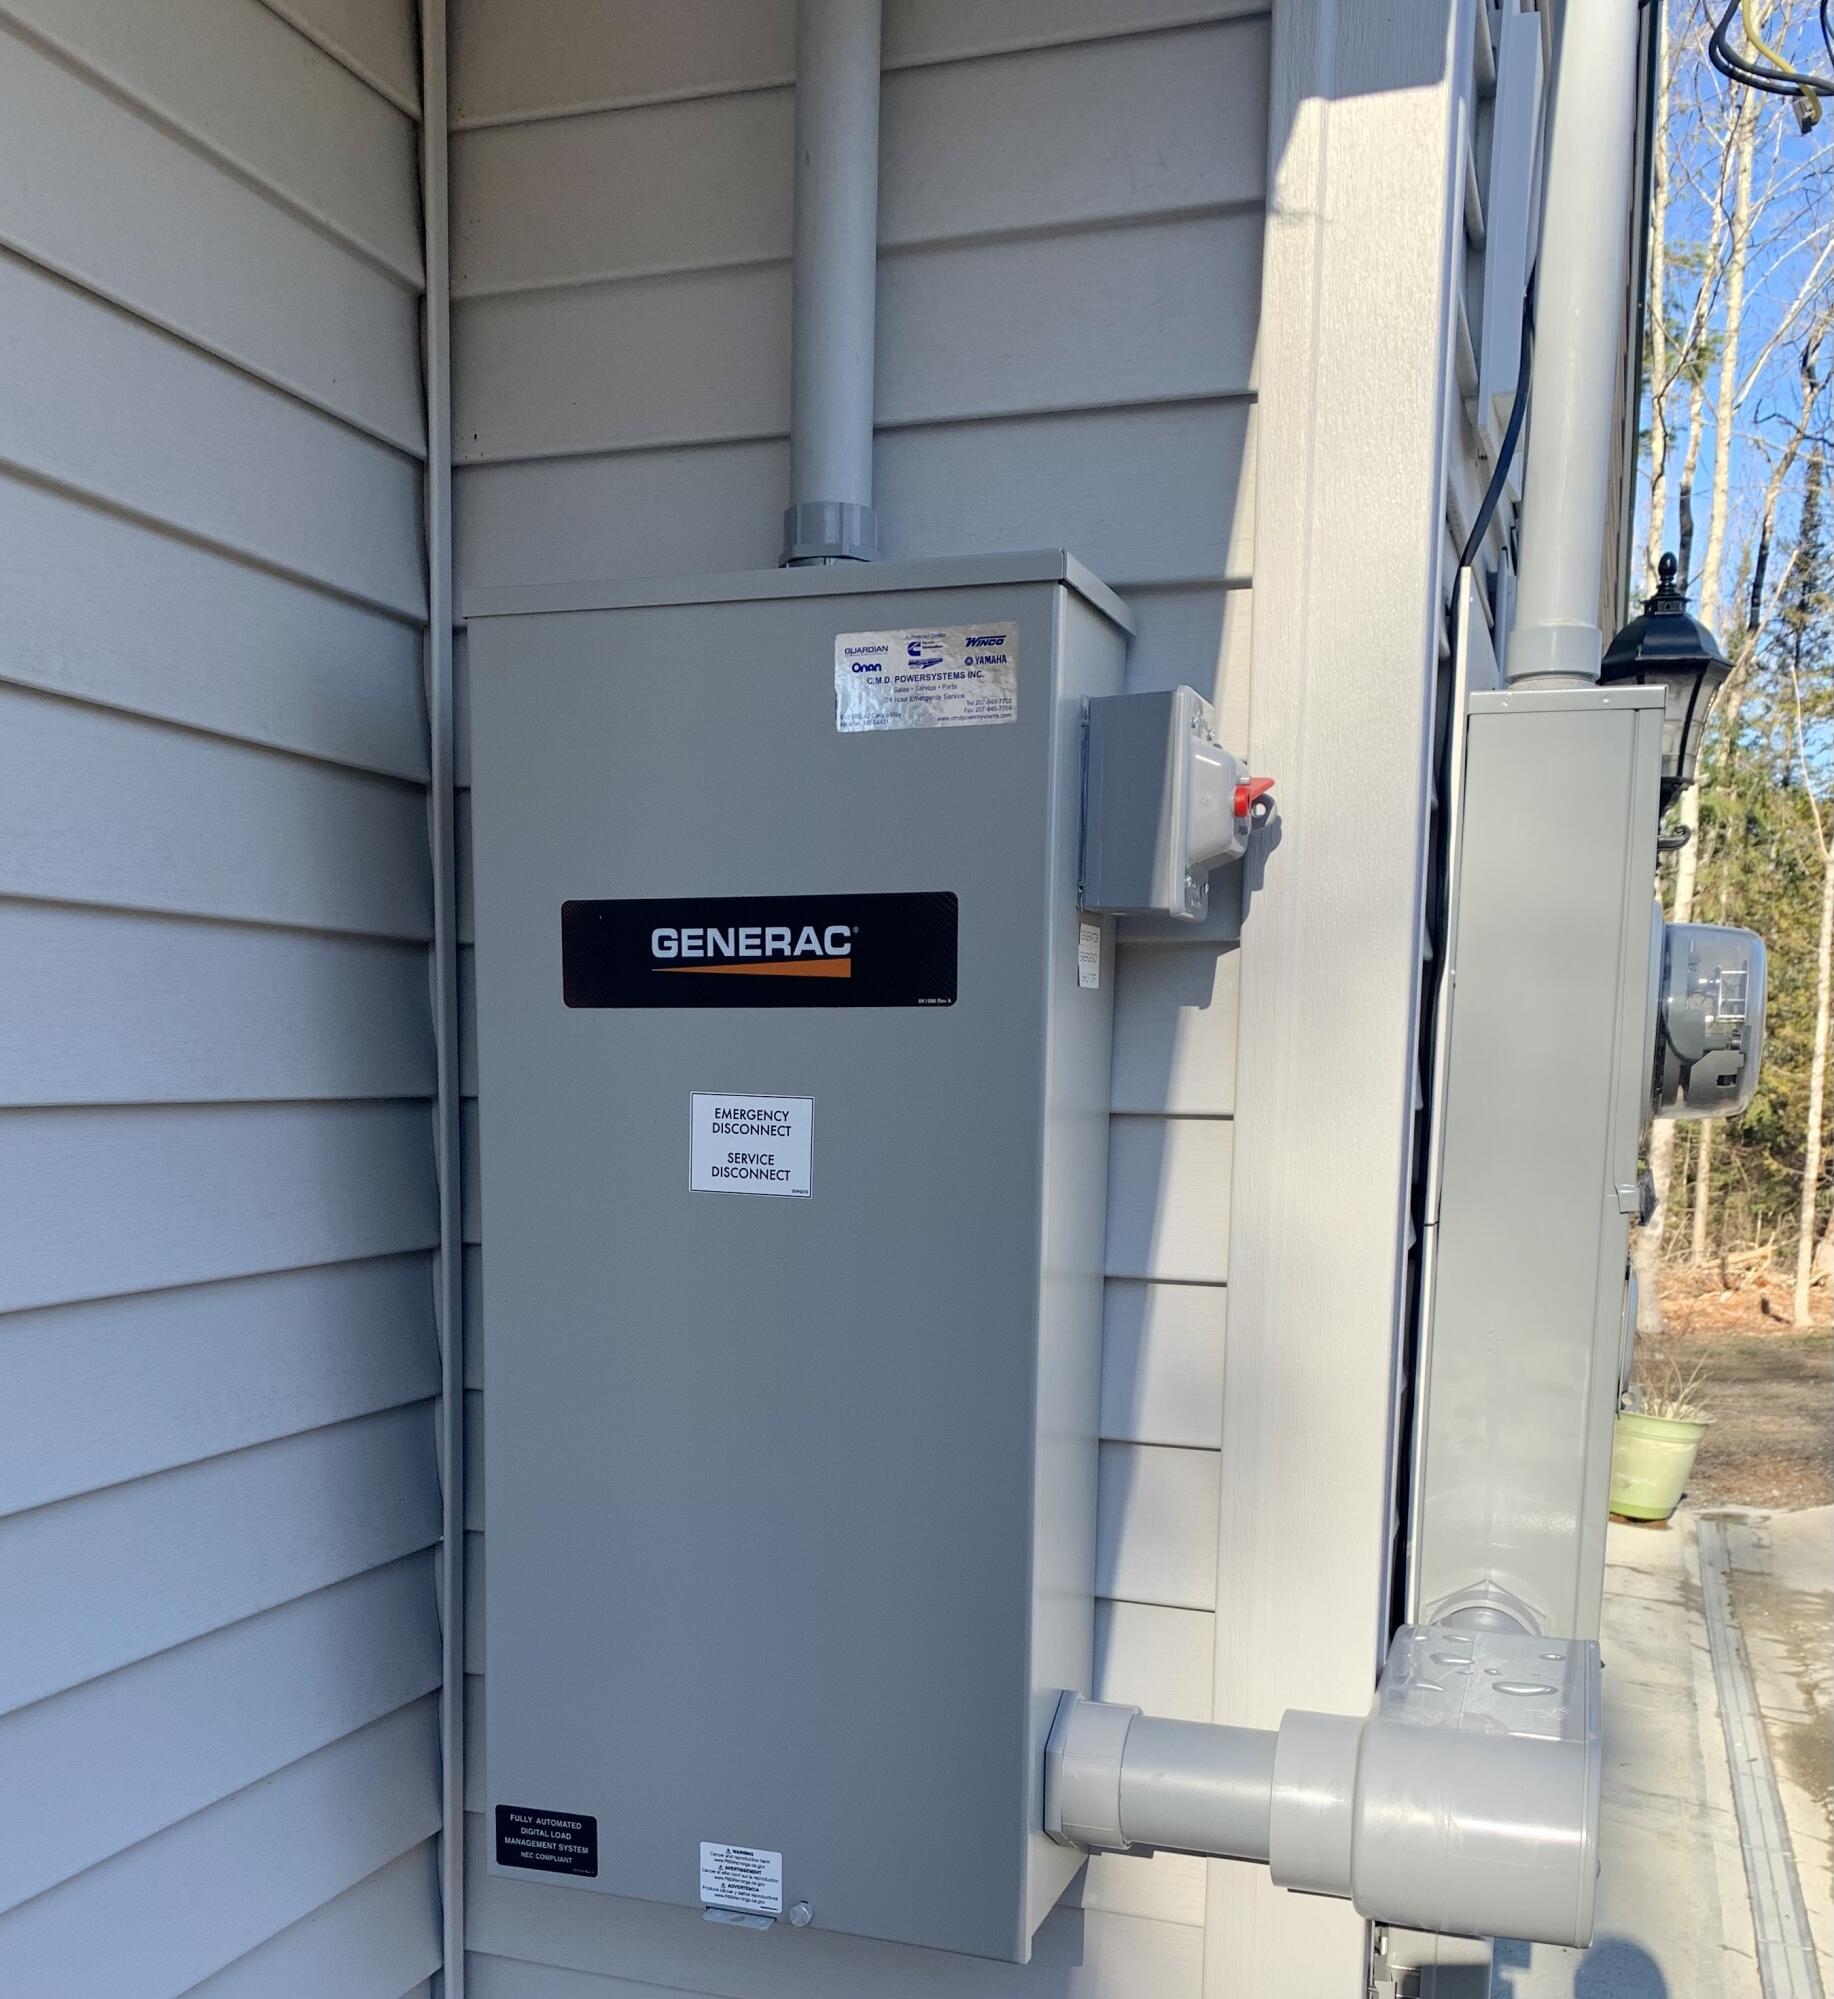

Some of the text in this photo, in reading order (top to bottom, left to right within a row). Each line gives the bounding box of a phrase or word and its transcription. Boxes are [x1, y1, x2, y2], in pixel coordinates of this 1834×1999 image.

[844, 645, 889, 656] GUARDIAN
[975, 654, 1007, 665] YAMAHA
[852, 662, 882, 673] Onan
[894, 671, 965, 684] POWERSYSTEMS
[967, 670, 985, 679] INC.
[651, 925, 851, 958] GENERAC
[714, 1107, 790, 1122] EMERGENCY
[712, 1122, 792, 1137] DISCONNECT
[727, 1152, 775, 1166] SERVICE
[711, 1166, 791, 1181] DISCONNECT
[510, 1813, 582, 1830] FULLY AUTOMATED
[520, 1827, 572, 1841] DIGITAL LOAD
[504, 1836, 589, 1854] MANAGEMENT SYSTEM
[520, 1851, 573, 1864] NEC COMPLIANT
